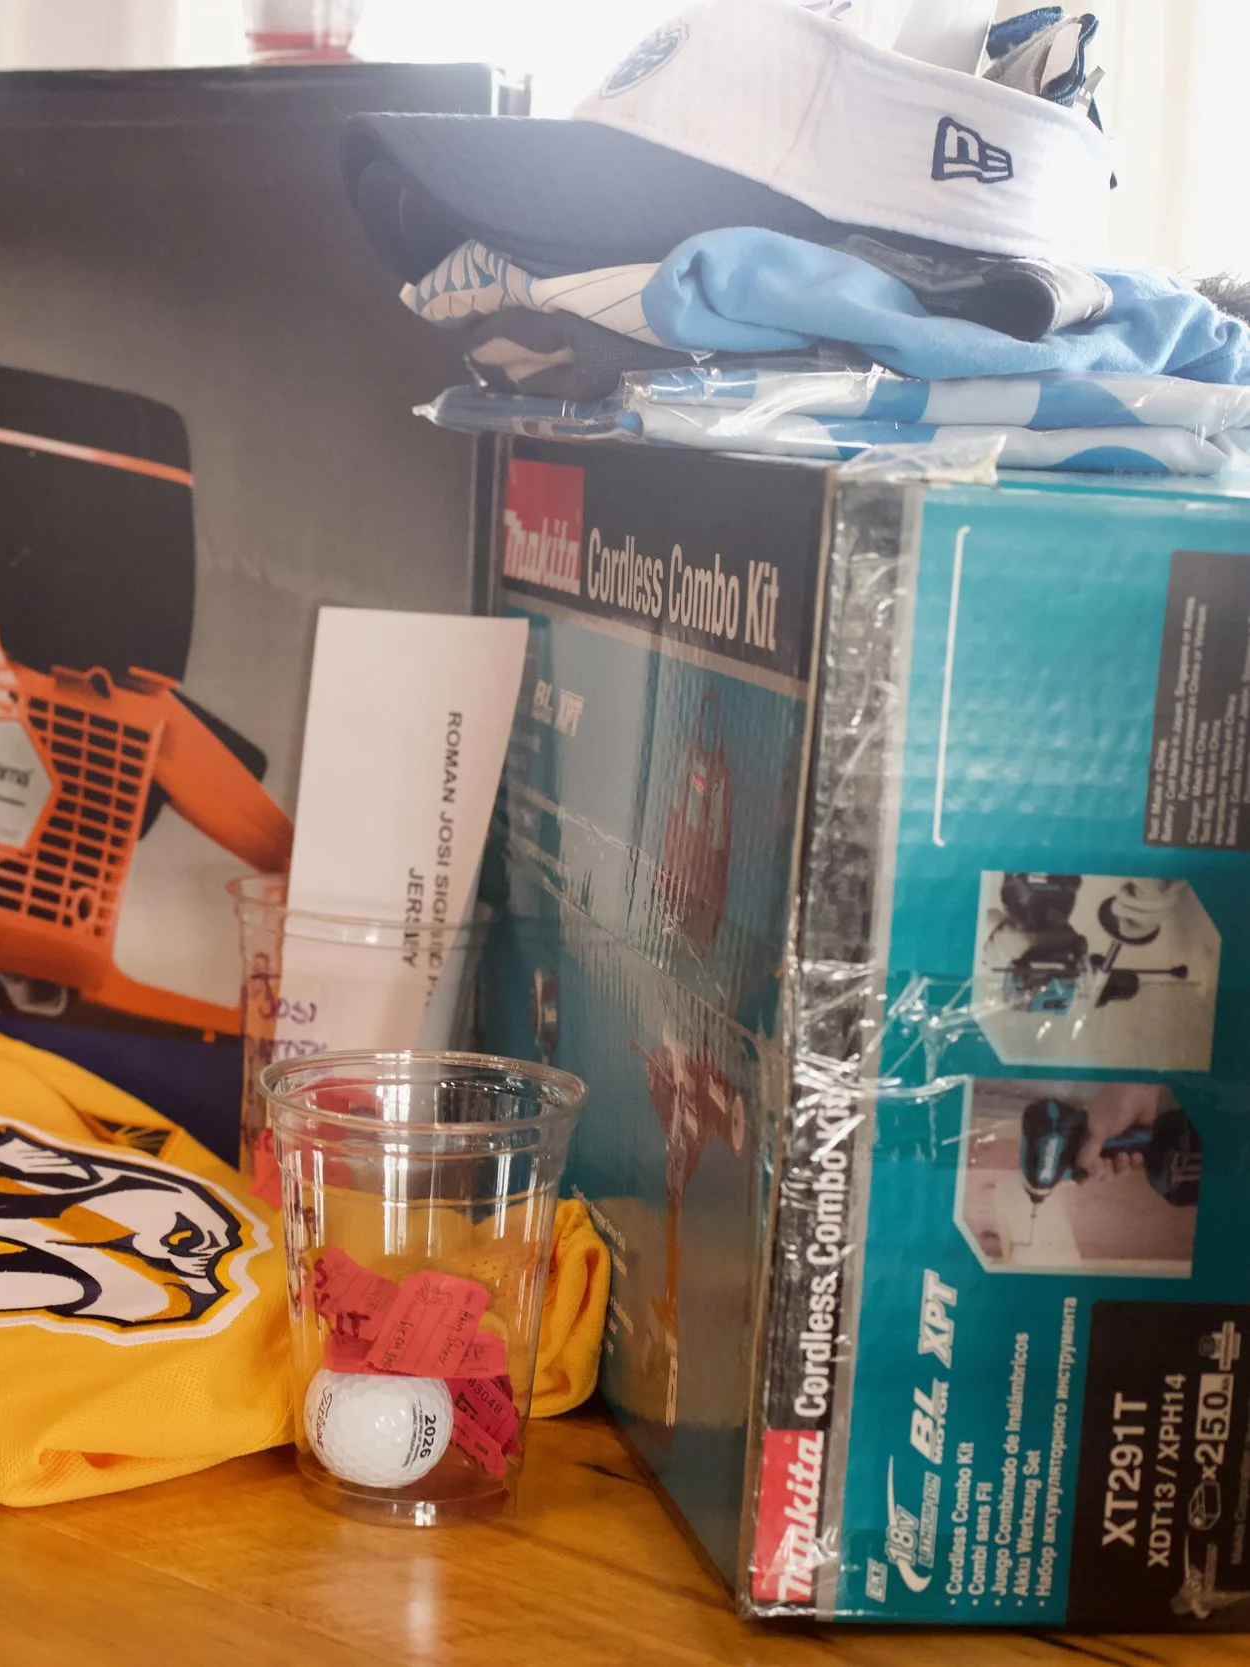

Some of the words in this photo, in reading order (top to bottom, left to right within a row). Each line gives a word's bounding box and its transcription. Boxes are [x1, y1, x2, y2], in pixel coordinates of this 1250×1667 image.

[587, 527, 664, 618] Cordless
[668, 543, 740, 640] Combo
[744, 559, 780, 652] Kit
[442, 711, 462, 803] ROMAN
[437, 811, 454, 866] JOSI
[806, 1151, 848, 1265] Combo
[793, 1274, 836, 1417] Cordless
[919, 1269, 957, 1367] XPT
[1055, 1297, 1078, 1399] инструмента
[1006, 1332, 1029, 1432] Inalámbricos
[1158, 1373, 1187, 1460] XPH14
[420, 1414, 436, 1458] 2026
[910, 1386, 937, 1461] BL
[956, 1442, 974, 1464] Kit
[1003, 1435, 1021, 1454] de
[951, 1467, 973, 1523] Combo
[975, 1482, 993, 1501] Fil
[1022, 1450, 1041, 1476] Set
[1043, 1403, 1069, 1543] аккумуляторного
[1101, 1391, 1147, 1547] XT291T
[974, 1505, 992, 1542] sans
[995, 1457, 1019, 1545] Combinado
[1017, 1479, 1042, 1553] Werkzeug
[1147, 1483, 1176, 1568] XDT13
[947, 1527, 968, 1595] Cordless
[969, 1545, 988, 1595] Combi
[991, 1548, 1012, 1596] Juego
[1013, 1557, 1033, 1597] Akku
[1035, 1547, 1058, 1596] Набор
